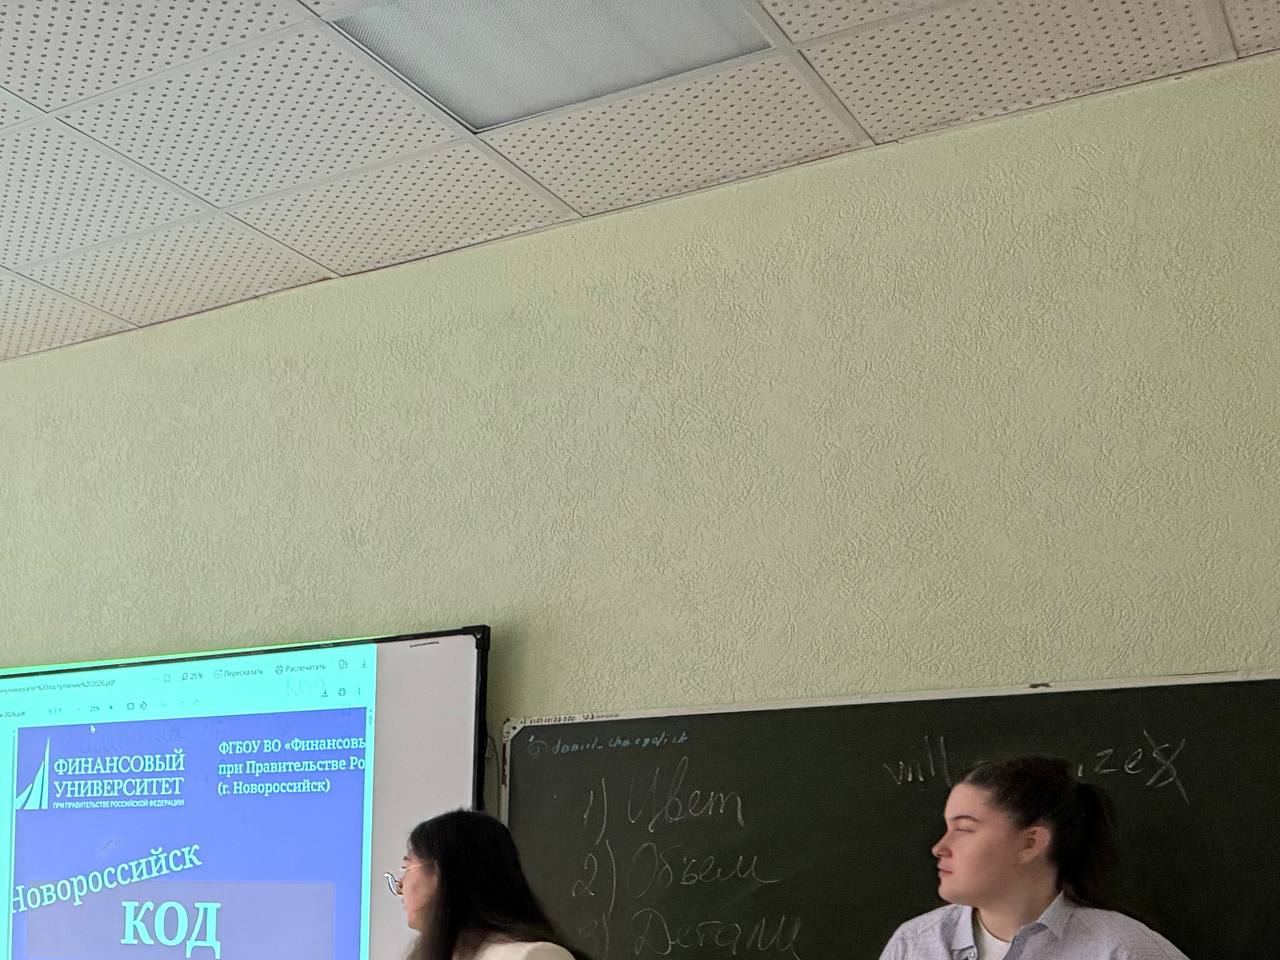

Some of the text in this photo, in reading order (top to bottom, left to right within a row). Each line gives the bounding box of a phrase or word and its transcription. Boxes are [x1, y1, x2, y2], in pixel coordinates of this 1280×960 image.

[223, 667, 265, 679] Пересказать
[284, 663, 327, 674] Распечатать
[219, 740, 261, 755] ФГБОУ
[264, 739, 282, 753] ВО
[53, 747, 186, 776] ФИНАНСОВЫЙ
[219, 756, 365, 778] при Правительстве Ро
[53, 777, 185, 798] УНИВЕРСИТЕТ
[218, 778, 331, 797] (г. Новороссийск)
[53, 798, 185, 809] ПРИ ПРАВИТЕЛЬСТВЕ РОССИЙСКОЙ ФЕДЕРАЦИИ
[11, 844, 203, 913] Новороссийск
[120, 900, 222, 960] КОД
